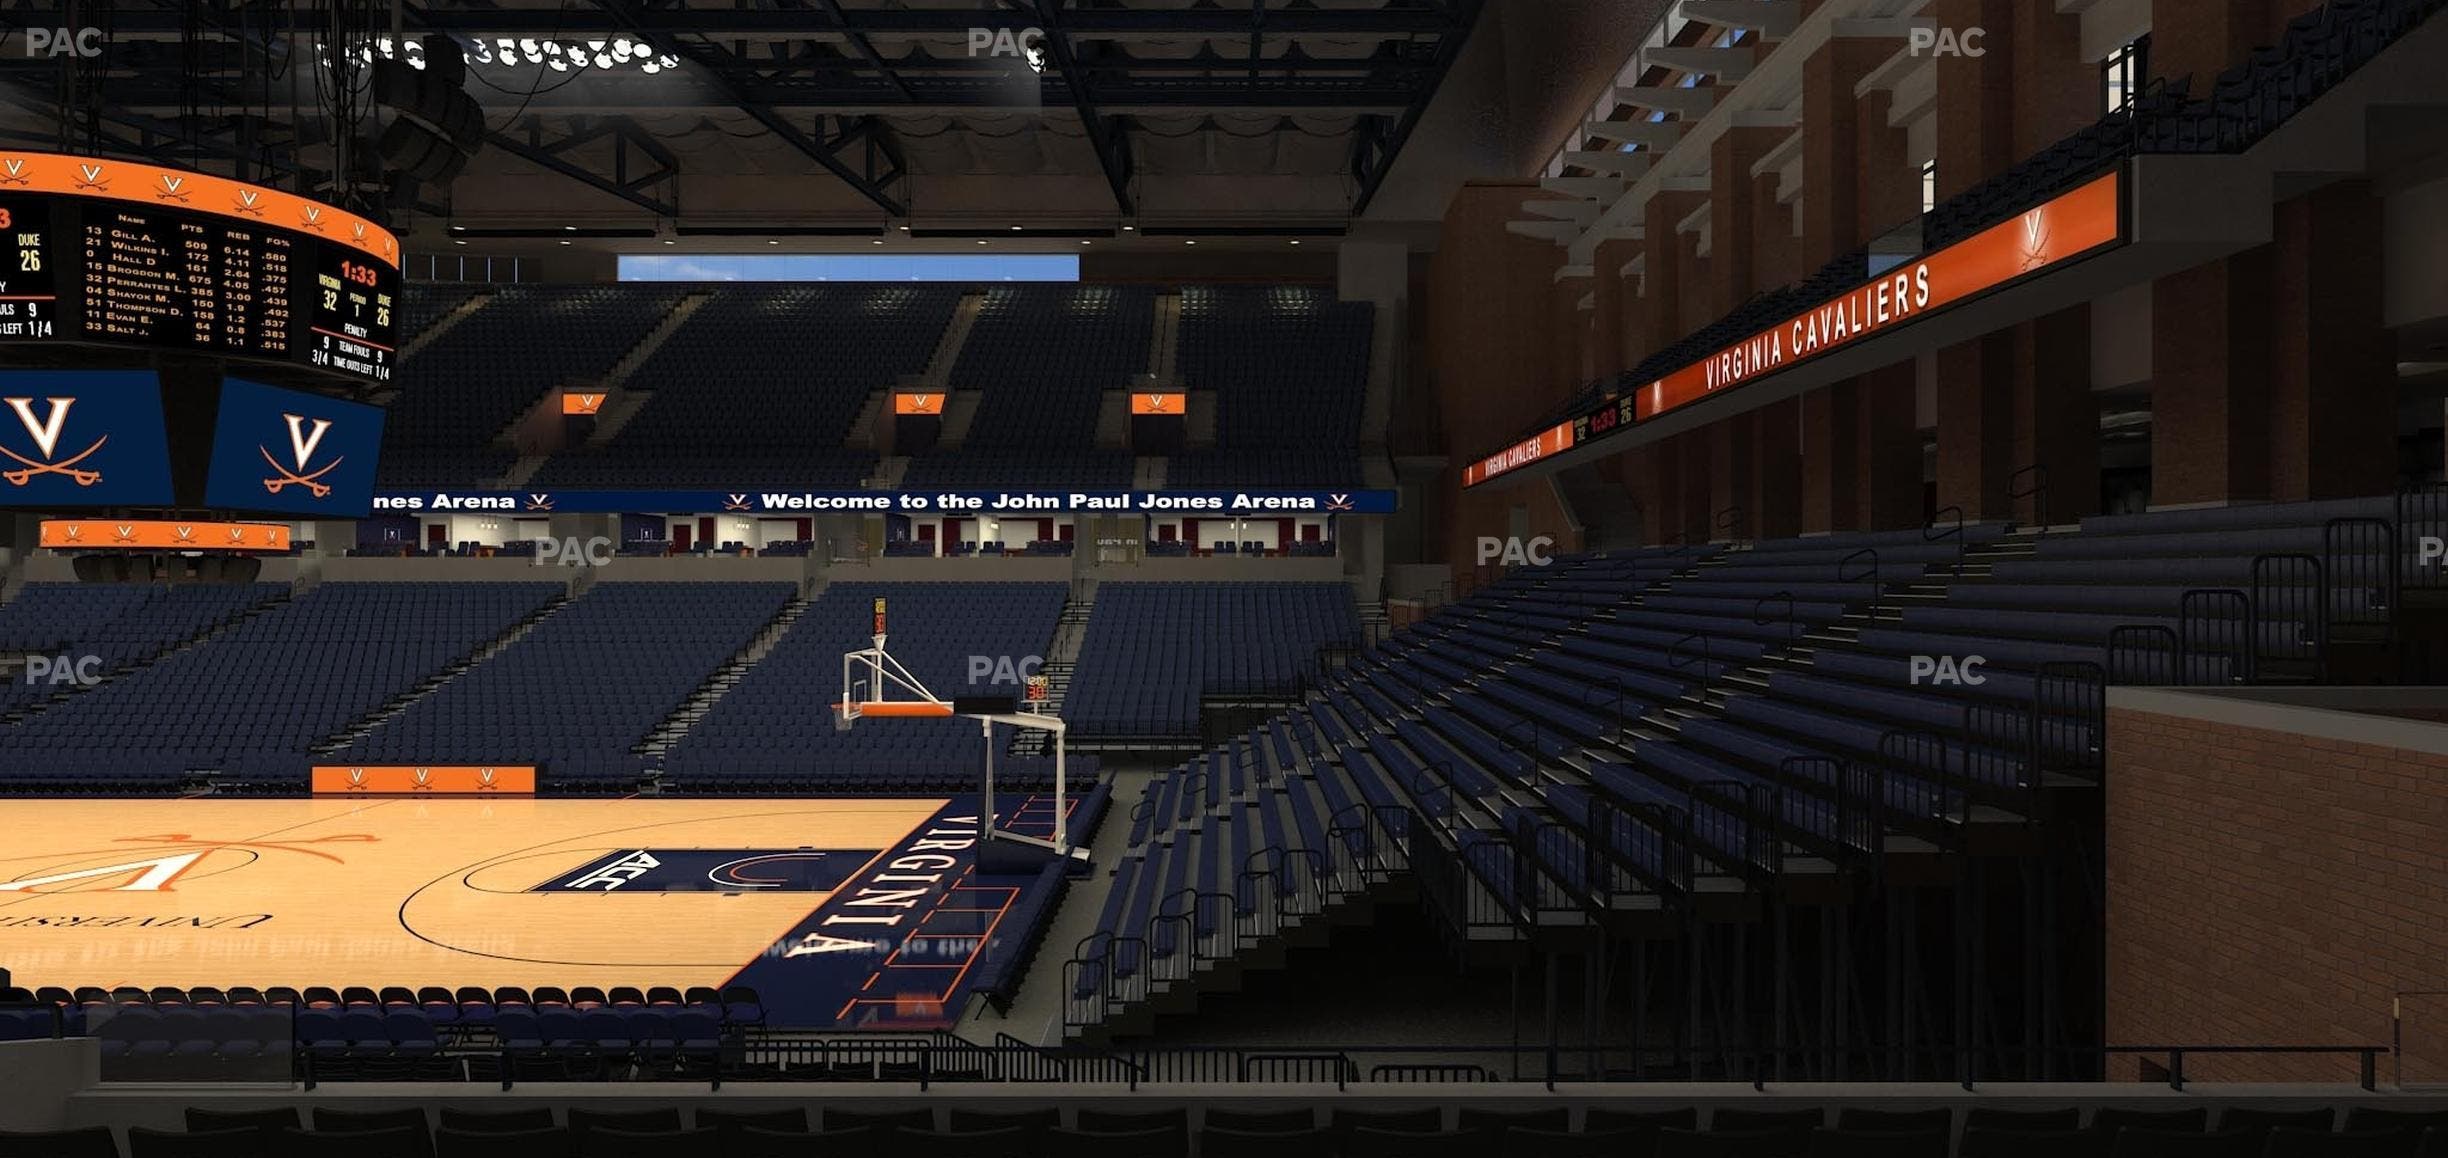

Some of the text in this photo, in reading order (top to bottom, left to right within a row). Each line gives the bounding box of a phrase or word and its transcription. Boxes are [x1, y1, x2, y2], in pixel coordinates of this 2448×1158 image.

[18, 233, 41, 246] DUKE
[86, 226, 102, 235] 13
[185, 240, 208, 250] 509
[224, 246, 250, 256] 6.14
[20, 250, 41, 271] 26
[85, 237, 101, 246] 21
[187, 252, 209, 262] 172
[224, 257, 250, 267] 4.11
[262, 263, 287, 272] .518
[86, 249, 94, 257] 0
[146, 258, 156, 266] D
[224, 268, 250, 278] 2.64
[262, 274, 287, 284] .375
[86, 273, 102, 283] 32
[225, 291, 251, 301] 3.00
[87, 262, 102, 270] 15
[189, 275, 212, 285] 675
[223, 279, 250, 289] 4.05
[260, 285, 286, 294] .457
[341, 260, 377, 287] 1:33
[28, 302, 37, 318] 9
[86, 285, 102, 294] 04
[192, 299, 214, 309] 150
[323, 289, 338, 312] 32
[354, 304, 359, 317] 1
[86, 298, 101, 307] 51
[226, 315, 246, 324] 1.2
[86, 310, 101, 319] 11
[195, 322, 211, 331] 64
[377, 307, 391, 327] 26
[2, 322, 23, 335] LEFT
[28, 320, 52, 338] 1/4
[86, 322, 102, 331] 33
[195, 333, 210, 343] 36
[226, 337, 244, 346] 1.1
[260, 341, 286, 351] .515
[1705, 263, 1929, 390] VIRGINIA CAVALIERS
[323, 336, 330, 349] 9
[377, 350, 383, 363] 9
[311, 349, 329, 366] 3/4
[375, 364, 390, 381] 1/4
[3, 397, 77, 460] V
[283, 413, 333, 473] V
[431, 493, 516, 509] Arena
[761, 493, 1316, 509] Welcome to the John Paul Jones Arena
[564, 849, 661, 892] ACC
[784, 813, 1000, 958] VIRGINIA
